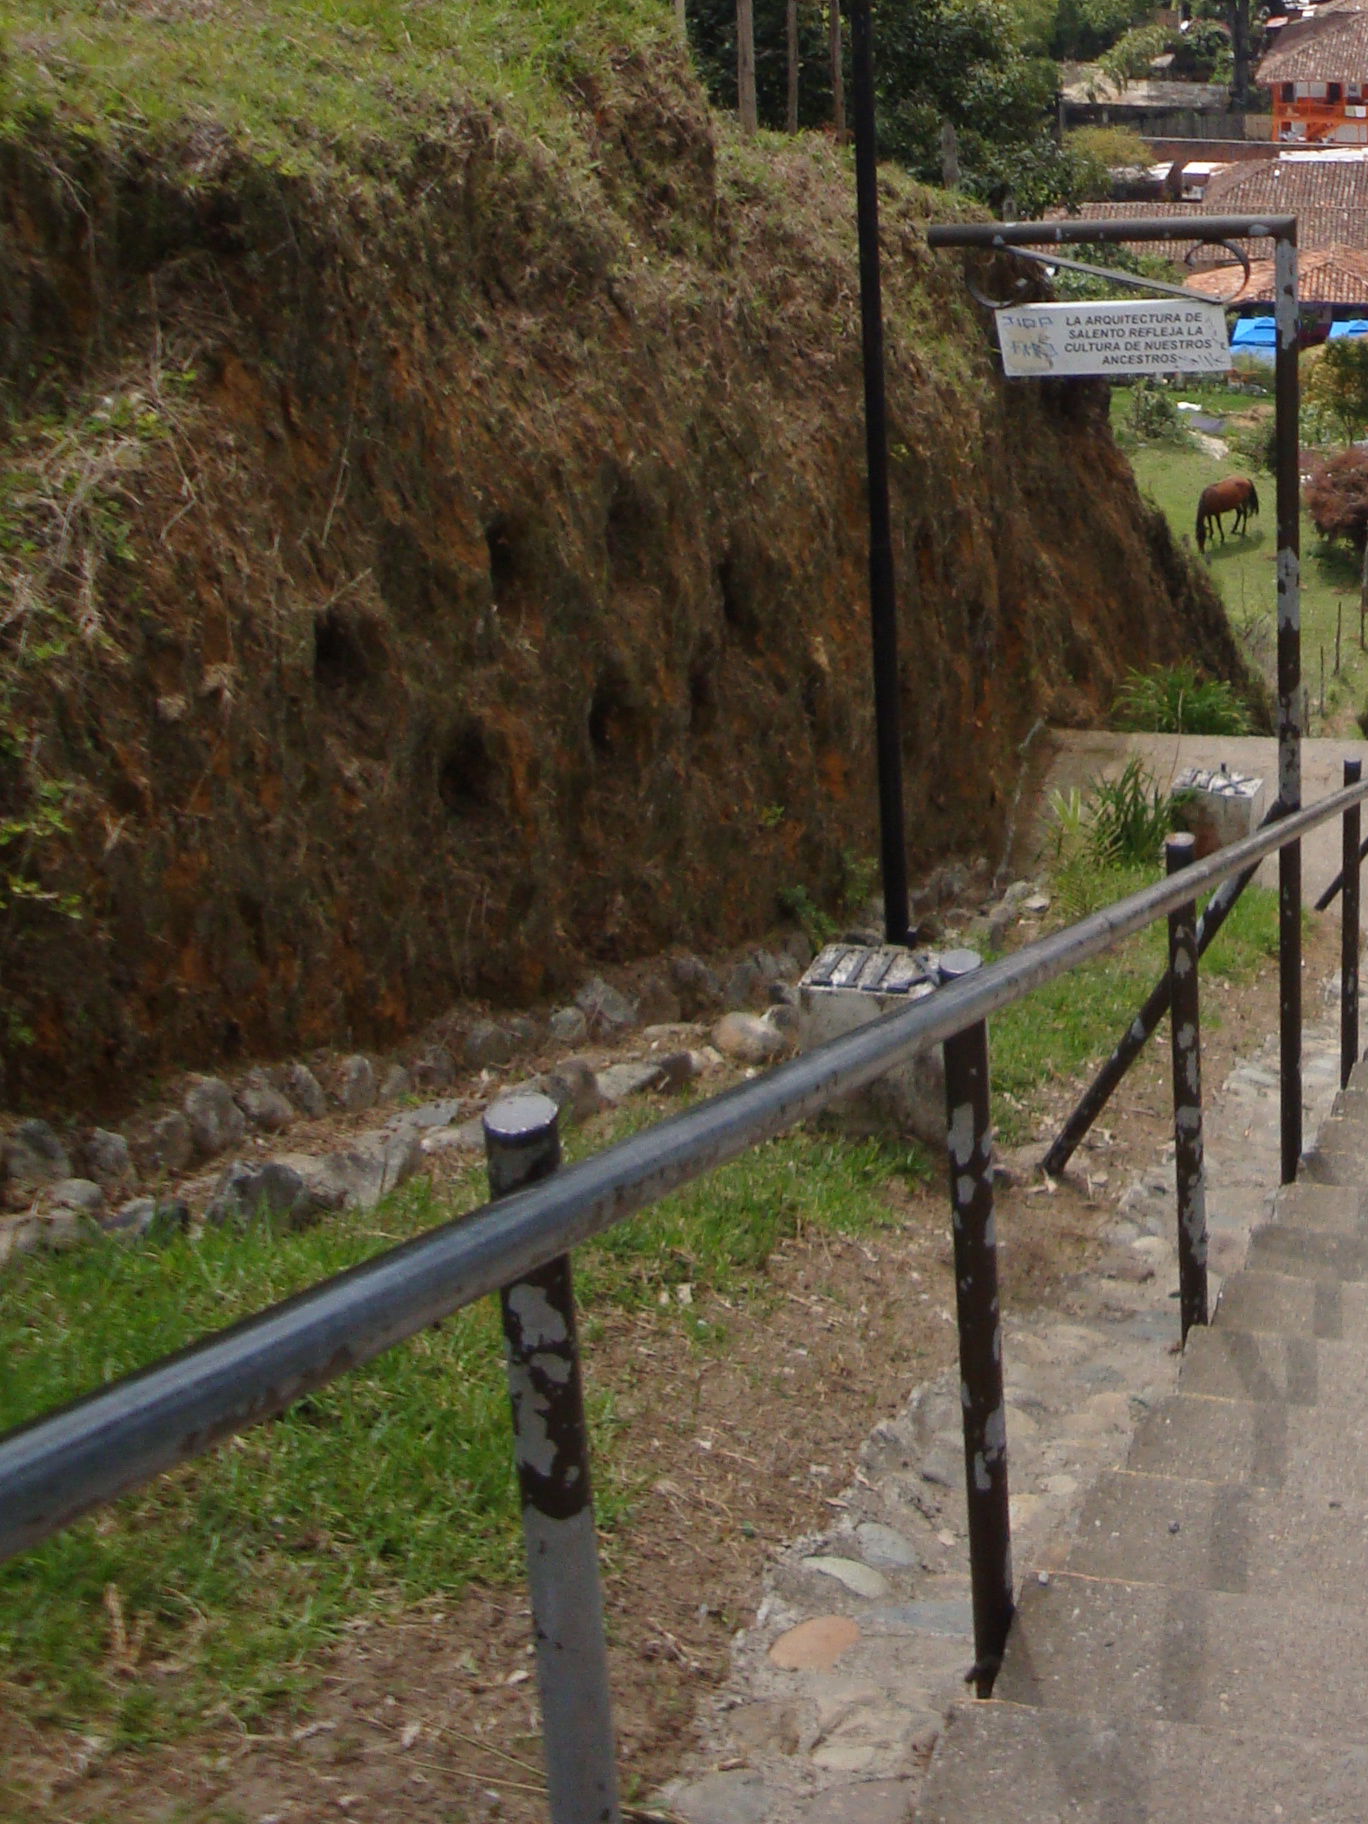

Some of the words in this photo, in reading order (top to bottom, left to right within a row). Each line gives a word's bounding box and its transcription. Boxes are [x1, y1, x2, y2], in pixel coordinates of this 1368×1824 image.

[1065, 314, 1081, 325] LA
[1085, 313, 1182, 325] ARQUITECTURA
[1185, 312, 1203, 323] DE
[1068, 328, 1125, 339] SALENTO
[1129, 327, 1184, 337] REFLEJA
[1187, 326, 1203, 336] LA
[1064, 342, 1120, 353] CULTURA
[1124, 341, 1140, 351] DE
[1144, 339, 1212, 351] NUESTROS
[1102, 354, 1177, 365] ANCESTROS
